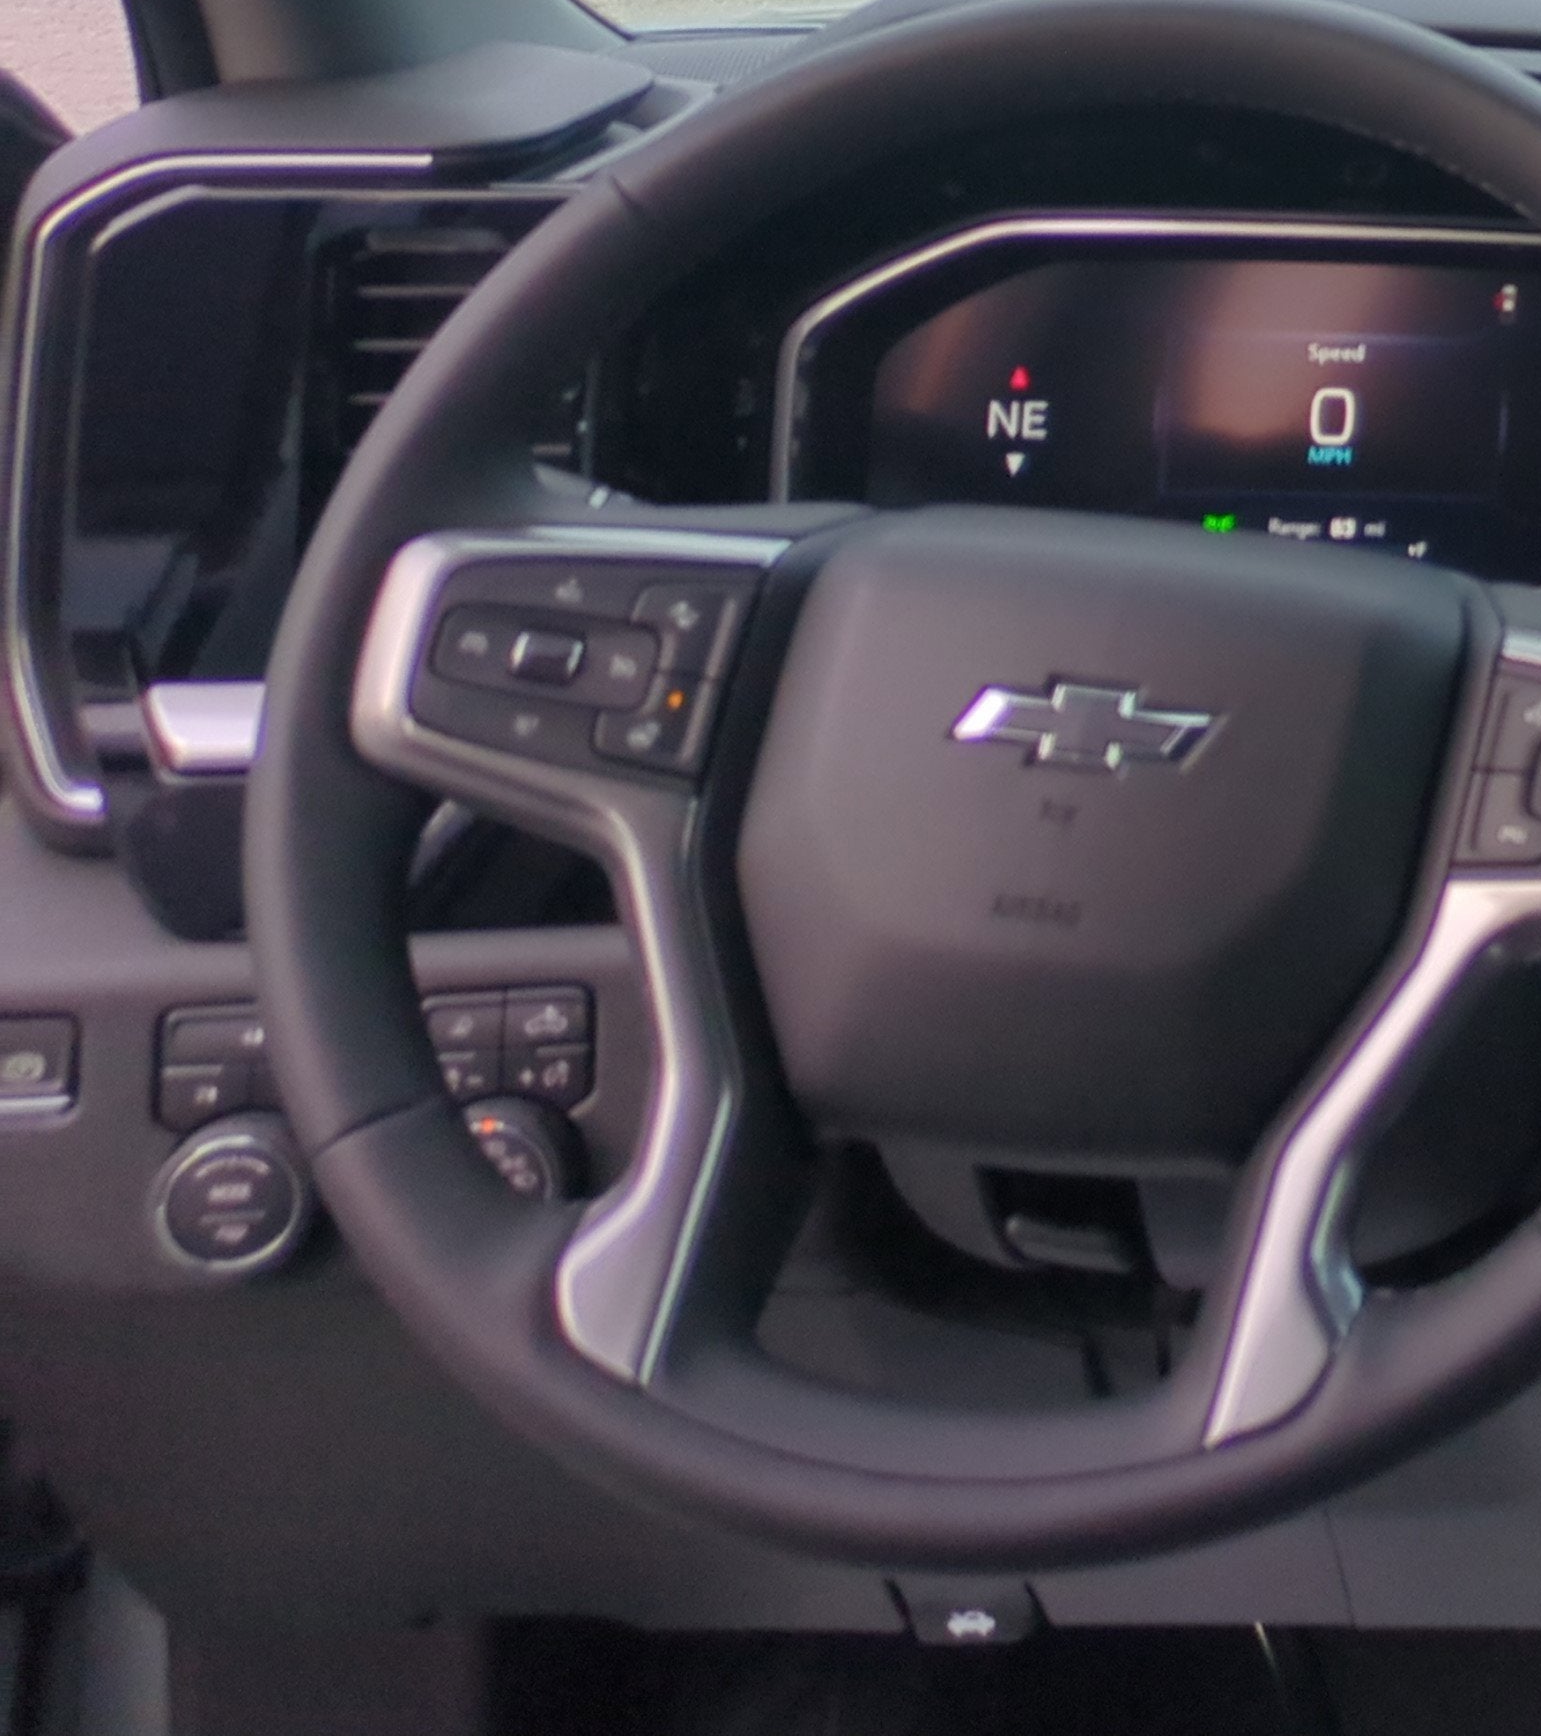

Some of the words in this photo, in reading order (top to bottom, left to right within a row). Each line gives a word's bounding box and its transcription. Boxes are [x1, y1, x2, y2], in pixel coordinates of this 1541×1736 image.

[1307, 342, 1366, 365] Speed
[987, 399, 1048, 441] NE
[1309, 386, 1356, 446] 0
[1306, 445, 1353, 466] MPH
